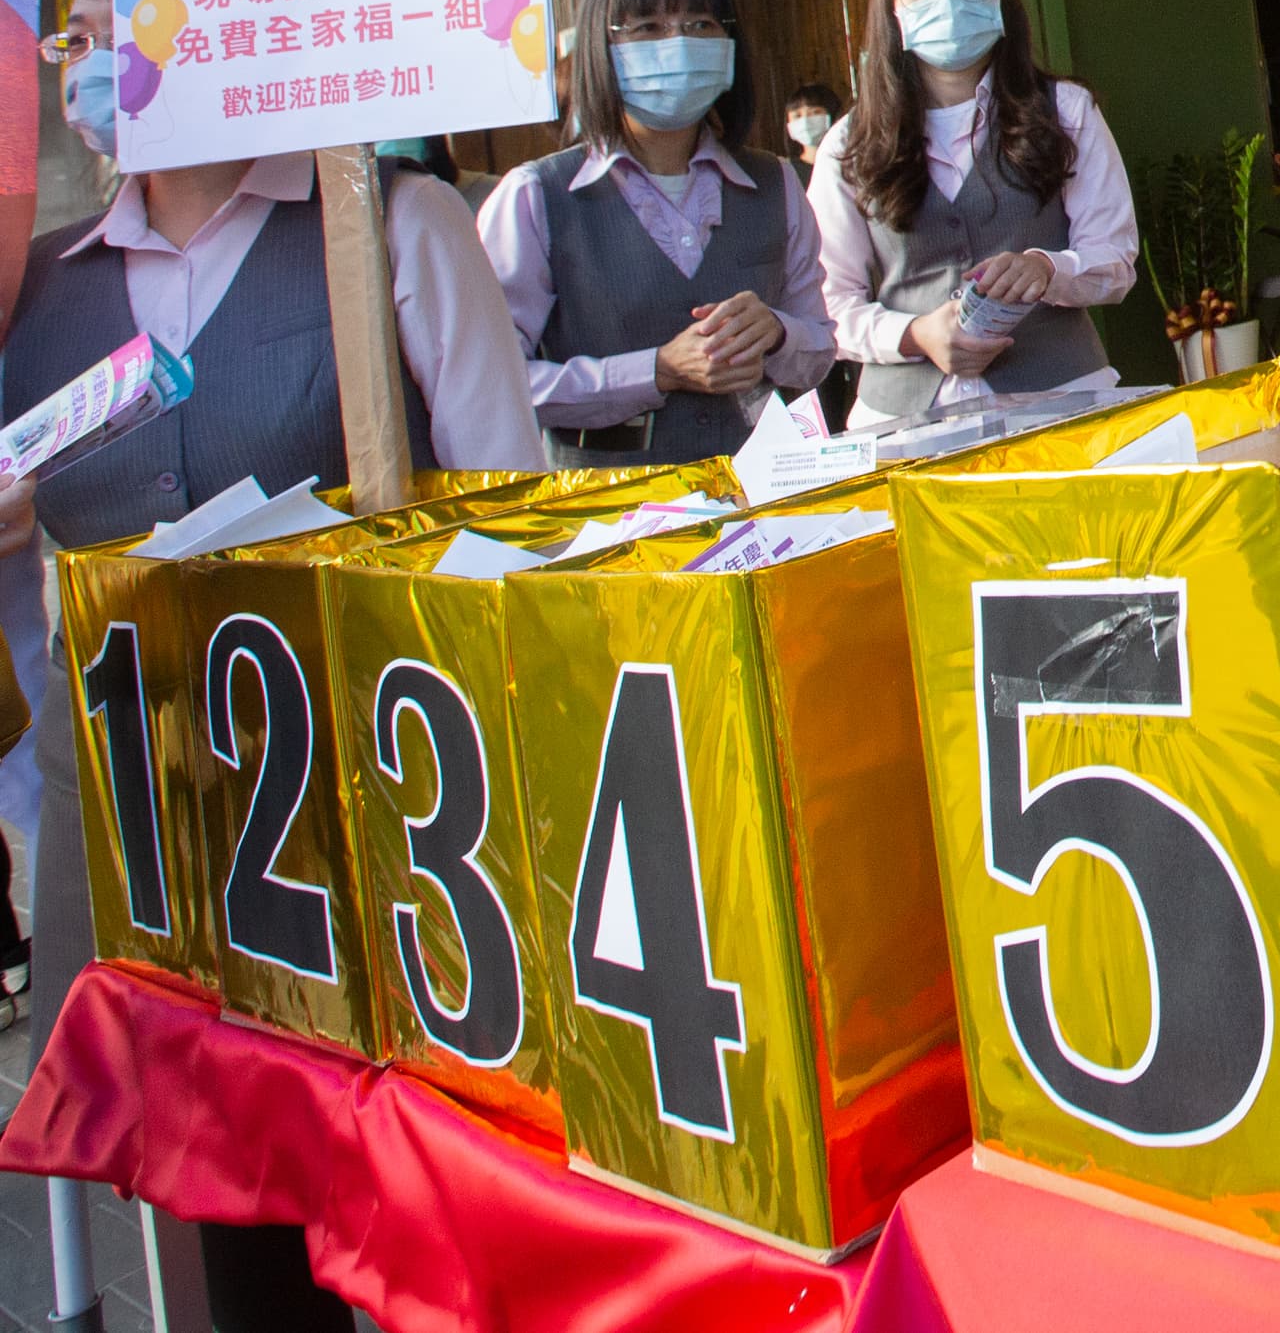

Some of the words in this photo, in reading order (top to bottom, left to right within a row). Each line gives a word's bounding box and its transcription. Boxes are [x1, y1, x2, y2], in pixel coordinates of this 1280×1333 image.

[221, 63, 437, 121] 歡迎蒞臨參加!
[86, 620, 171, 938] 1
[203, 611, 337, 982] 2
[374, 657, 527, 1070] 3
[570, 661, 745, 1144] 4
[972, 578, 1274, 1148] 5
